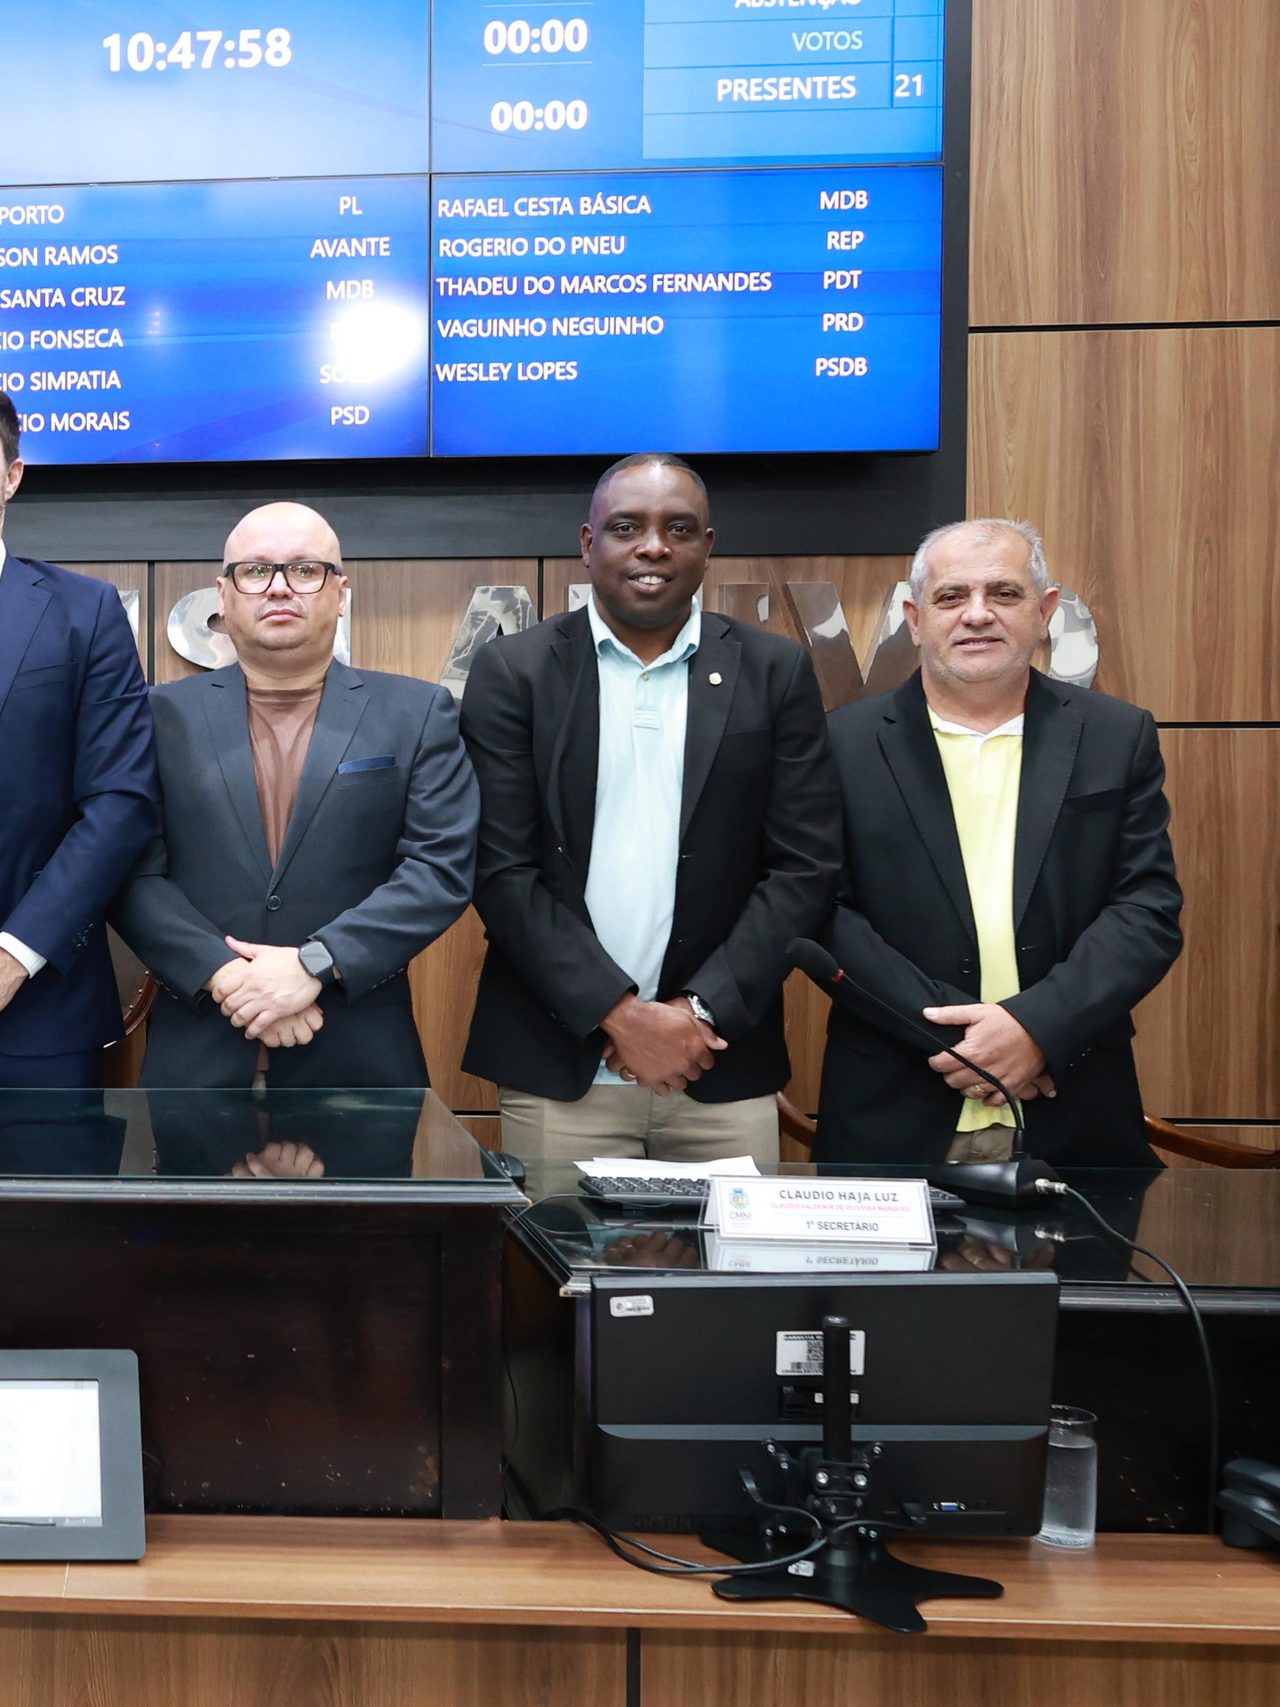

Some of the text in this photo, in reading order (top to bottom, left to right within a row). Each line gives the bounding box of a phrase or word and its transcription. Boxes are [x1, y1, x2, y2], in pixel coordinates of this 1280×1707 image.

[484, 19, 587, 54] 00:00
[792, 31, 862, 51] VOTOS
[103, 28, 292, 71] 10:47:58
[718, 74, 922, 101] PRESENTES 21
[491, 100, 587, 131] 00:00
[340, 196, 362, 214] PL
[438, 192, 651, 217] RAFAEL CESTA BÁSICA
[820, 191, 868, 209] MDB
[311, 237, 390, 257] AVANTE
[440, 236, 625, 257] ROGERIO DO PNEU
[827, 231, 864, 250] REP
[49, 245, 118, 266] RAMOS
[436, 272, 772, 296] THADEU DO MARCOS FERNANDES
[824, 270, 862, 289] PDT
[0, 288, 65, 308] SANTA
[71, 287, 125, 306] CRUZ
[326, 280, 374, 300] MDB
[437, 316, 664, 337] VAGUINHO NEGUINHO
[823, 313, 863, 331] PRD
[31, 329, 123, 349] FONSECA
[436, 361, 577, 381] WESLEY LOPES
[816, 357, 867, 376] PSDB
[30, 370, 121, 391] SIMPATIA
[51, 411, 130, 431] MORAIS
[330, 407, 369, 426] PSD
[780, 1190, 898, 1202] CLAUDIO HAJA LUZ
[816, 1220, 880, 1232] SECRETÁRIO
